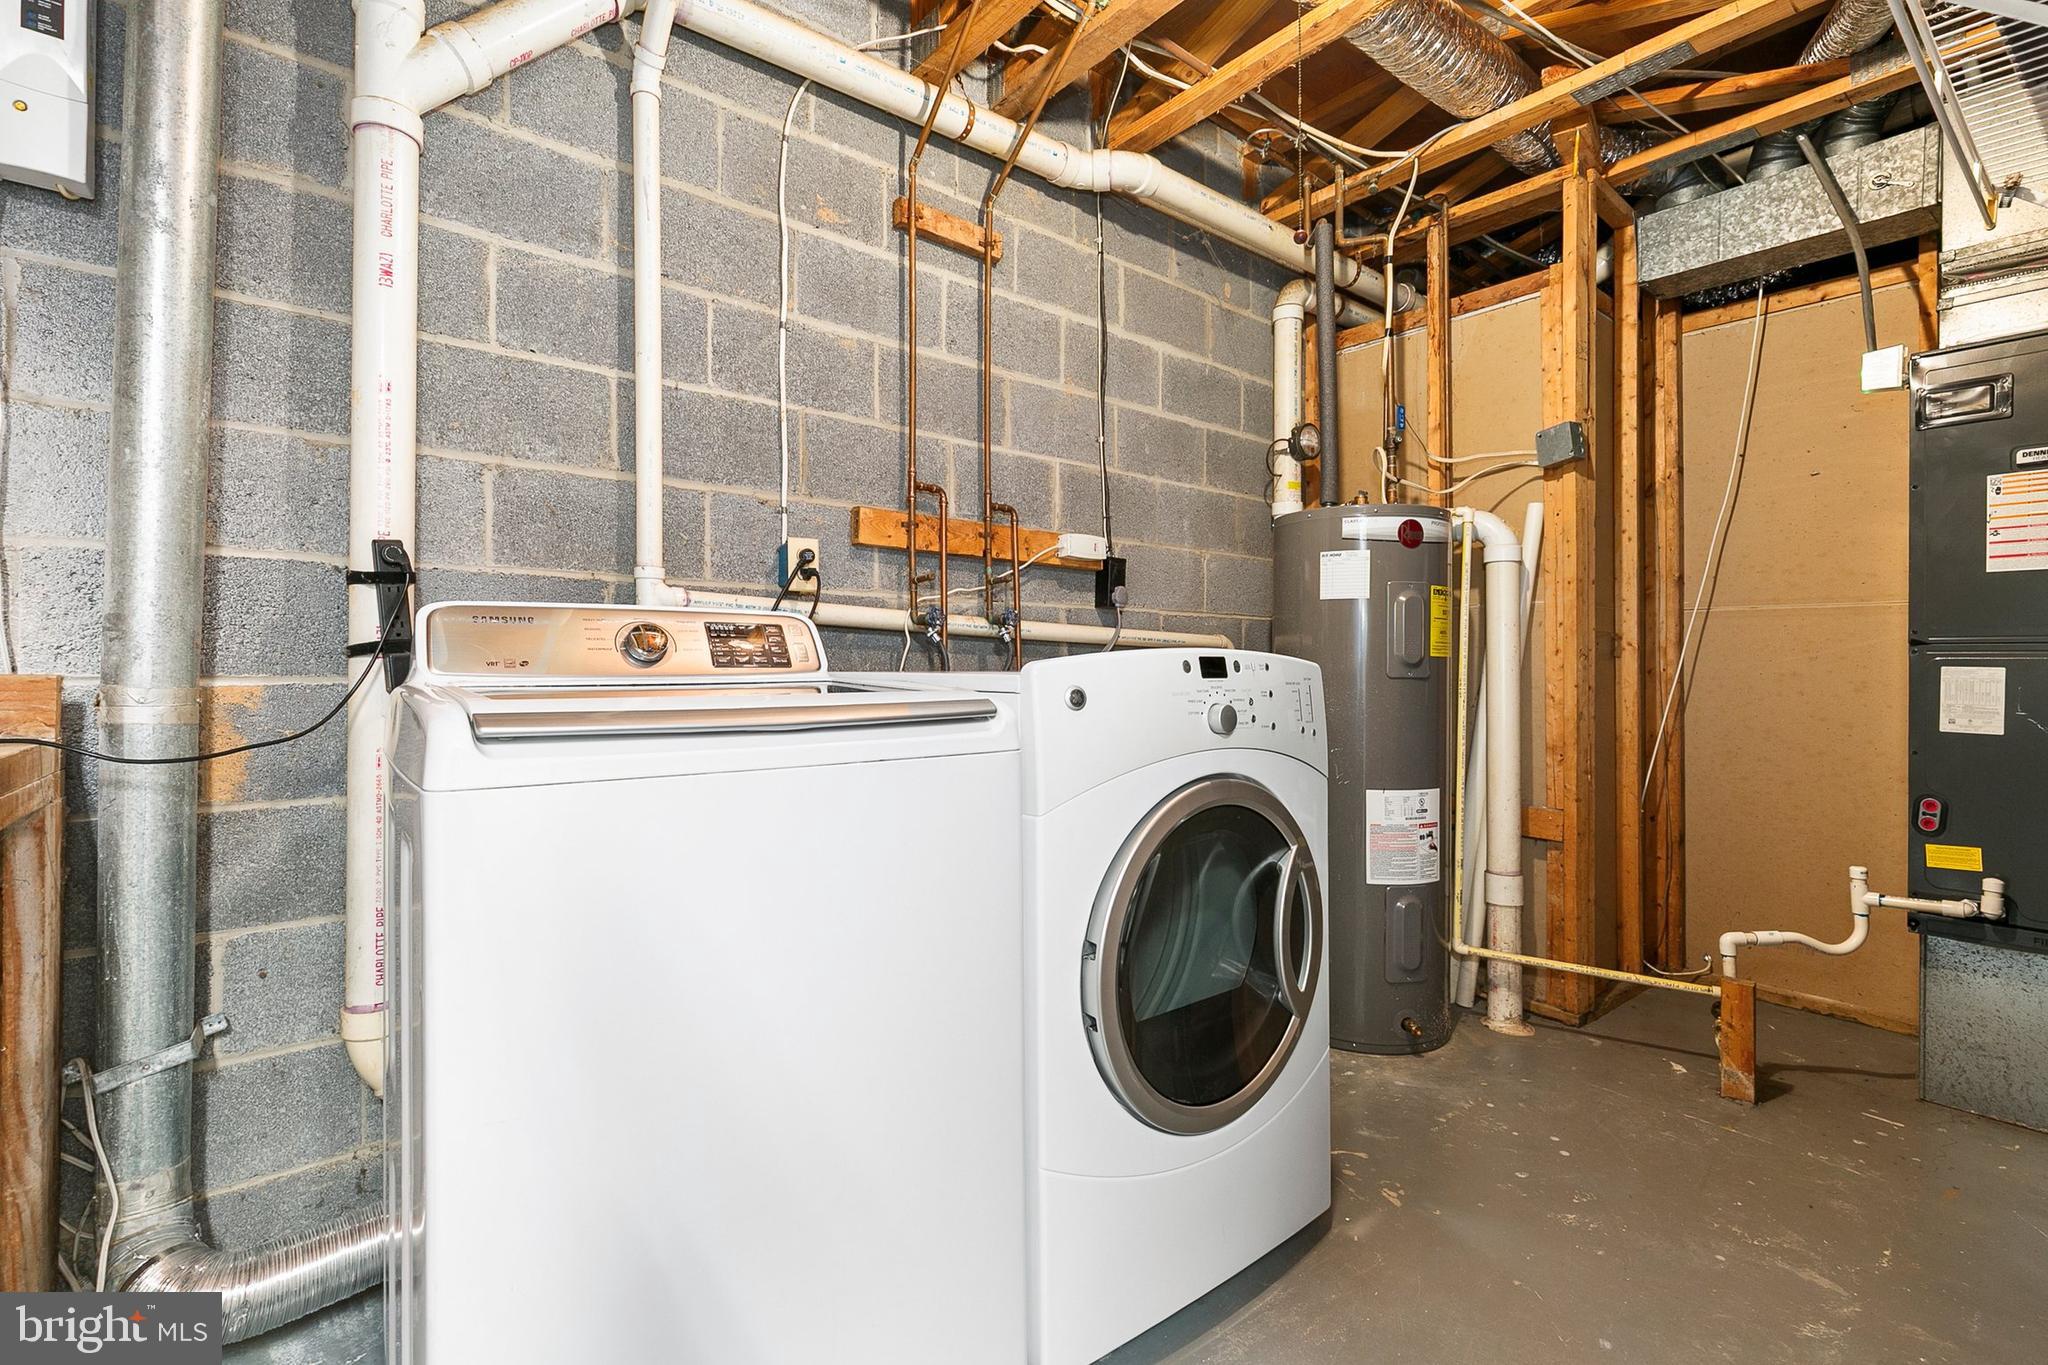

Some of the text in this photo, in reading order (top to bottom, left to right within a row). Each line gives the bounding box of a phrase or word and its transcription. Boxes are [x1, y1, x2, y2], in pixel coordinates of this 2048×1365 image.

[571, 13, 606, 37] CHARLOTTE
[380, 158, 393, 181] PIPE
[380, 183, 393, 238] CHARLOTTE
[472, 615, 535, 624] SAMSUNG
